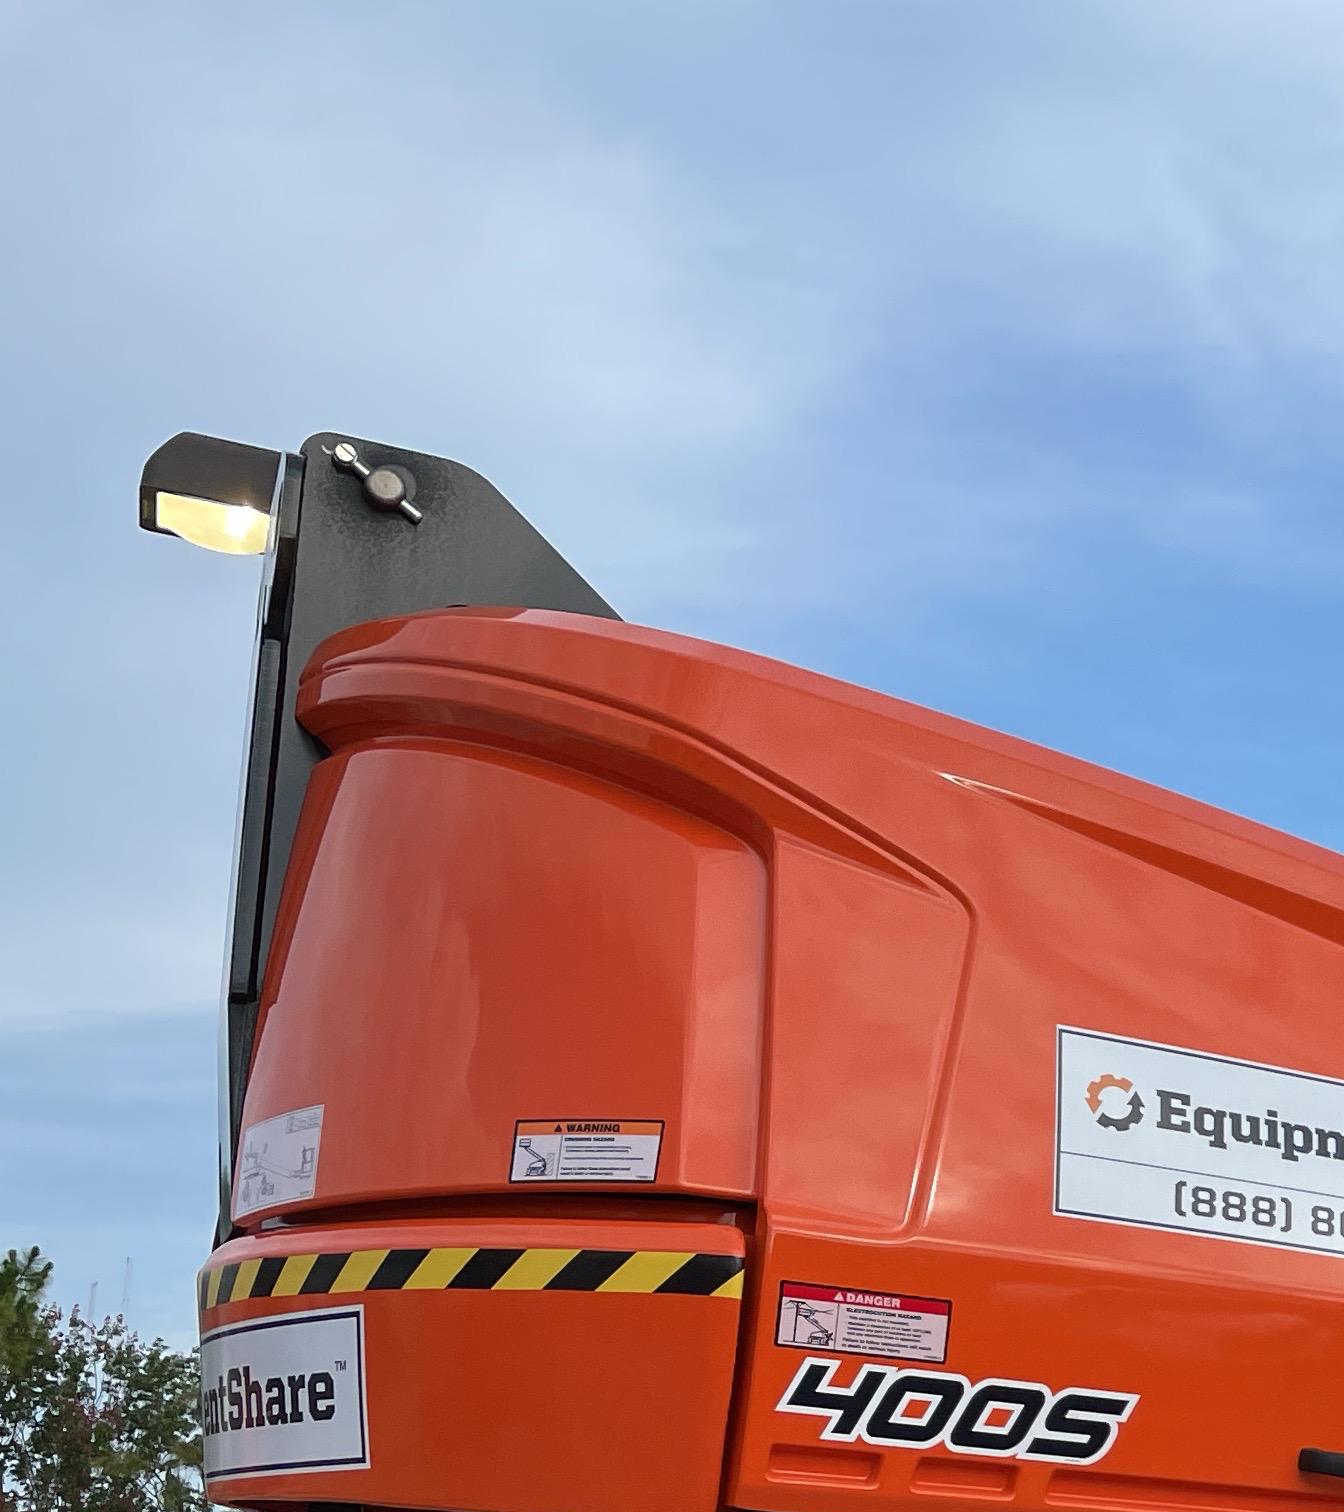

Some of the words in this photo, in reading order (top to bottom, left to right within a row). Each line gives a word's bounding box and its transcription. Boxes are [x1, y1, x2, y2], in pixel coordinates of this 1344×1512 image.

[566, 1123, 621, 1133] WARNING
[1174, 1180, 1293, 1233] (888)
[845, 1292, 902, 1308] DANGER
[776, 1357, 1141, 1466] 400S
